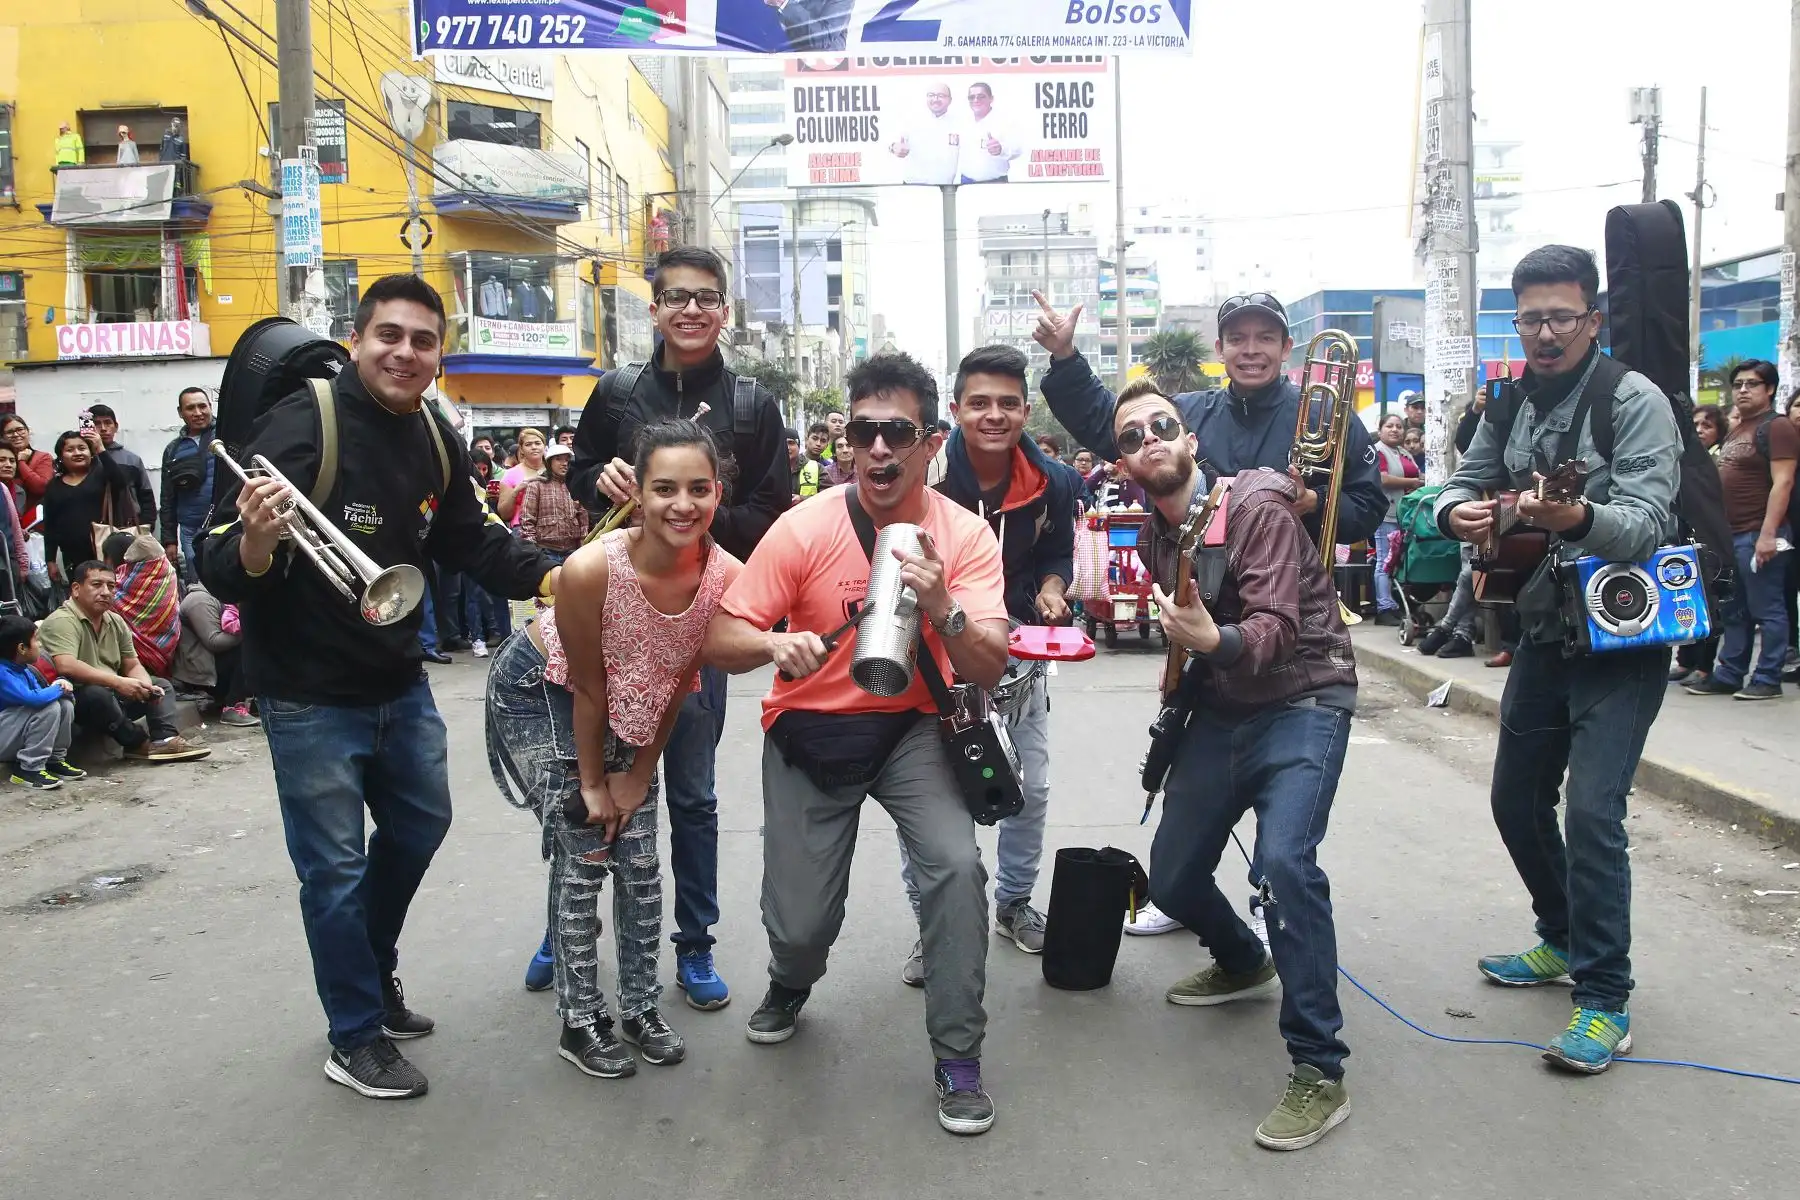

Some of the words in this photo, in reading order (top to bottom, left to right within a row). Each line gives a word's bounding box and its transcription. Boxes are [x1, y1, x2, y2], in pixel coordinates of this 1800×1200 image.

[1065, 0, 1162, 24] Bolsos
[436, 15, 482, 45] 977
[488, 14, 533, 45] 740
[539, 14, 587, 44] 252
[943, 36, 956, 48] JR.
[957, 36, 998, 48] GAMARRA
[999, 36, 1014, 48] 774
[1016, 36, 1050, 48] GALERIA
[1052, 36, 1093, 48] MONARCA
[1095, 36, 1110, 48] INT.
[1112, 36, 1127, 48] 223
[1134, 36, 1145, 48] LA
[1147, 36, 1185, 48] VICTORIA
[501, 60, 545, 89] Dental
[793, 85, 881, 113] DIETHELL
[1035, 81, 1094, 109] ISAAC
[796, 115, 880, 144] COLUMBUS
[1042, 111, 1088, 139] FERRO
[808, 152, 862, 168] ALCALDE
[1030, 149, 1086, 162] ALCALDE
[1088, 149, 1101, 162] DE
[810, 166, 829, 183] DE
[830, 166, 860, 183] LIMA
[1028, 164, 1043, 177] LA
[1045, 163, 1104, 177] VICTORIA
[480, 319, 502, 330] TERNO
[508, 321, 535, 331] CAMISA
[58, 322, 190, 354] CORTINAS
[343, 509, 383, 525] Táchira
